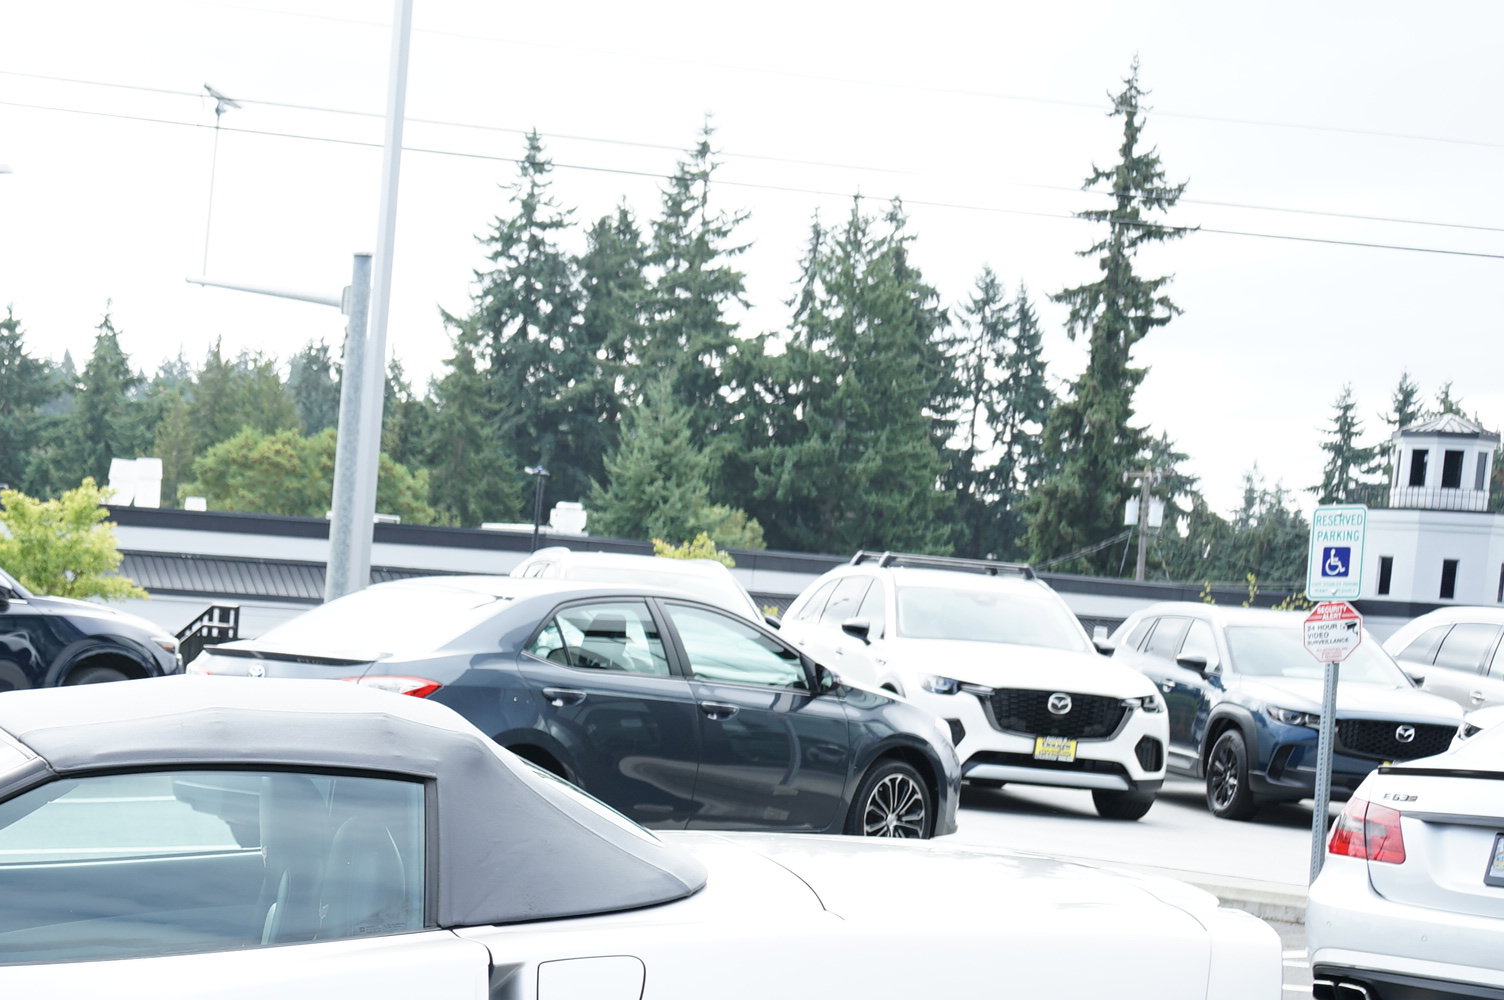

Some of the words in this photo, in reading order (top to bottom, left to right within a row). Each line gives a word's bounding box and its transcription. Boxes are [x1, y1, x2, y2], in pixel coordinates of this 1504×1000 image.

[1316, 513, 1363, 527] RESERVED
[1317, 530, 1360, 542] PARKING
[1317, 605, 1347, 614] SECURITY
[1322, 612, 1342, 620] ALERT
[1317, 623, 1337, 631] HOUR
